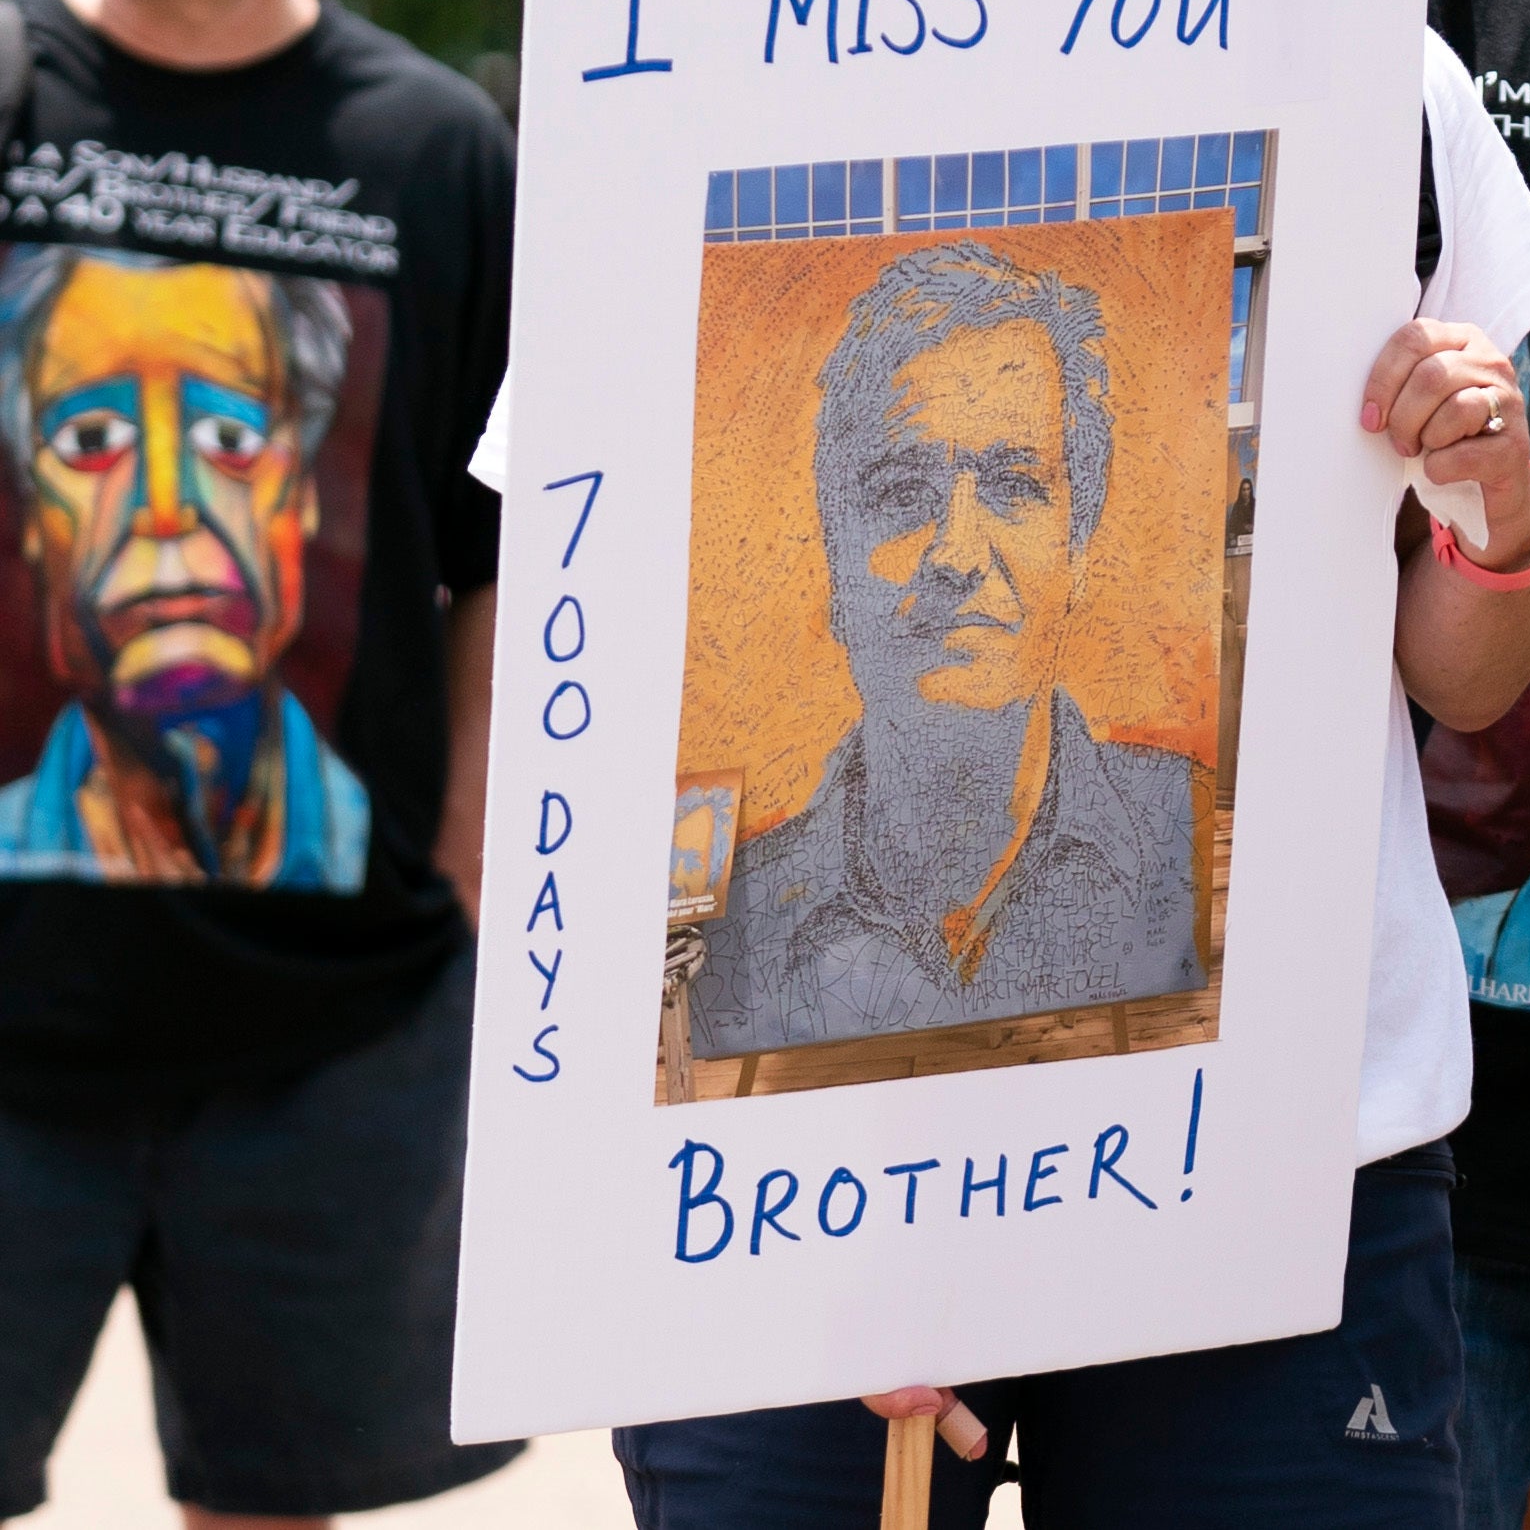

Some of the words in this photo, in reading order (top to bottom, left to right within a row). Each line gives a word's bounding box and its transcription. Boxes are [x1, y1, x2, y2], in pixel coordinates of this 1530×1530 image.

[543, 470, 603, 741] 700
[513, 790, 573, 1083] DAYS
[667, 1067, 1205, 1263] BROTHER!
